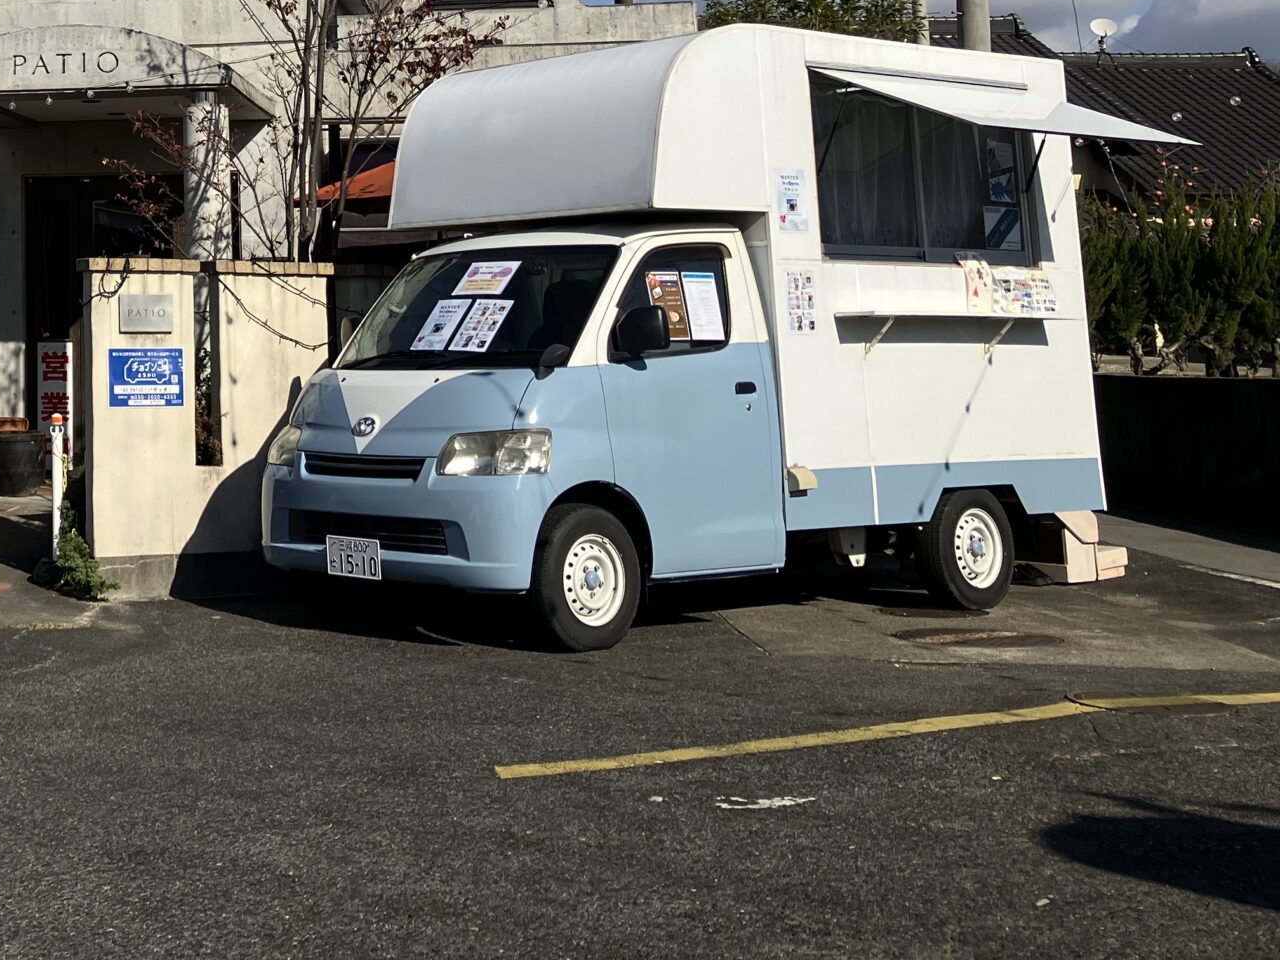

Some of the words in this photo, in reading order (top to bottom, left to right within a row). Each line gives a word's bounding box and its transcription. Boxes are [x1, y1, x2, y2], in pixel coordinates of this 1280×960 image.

[12, 51, 119, 76] PATIO
[127, 308, 166, 318] PATIO
[340, 553, 377, 576] 15-10
